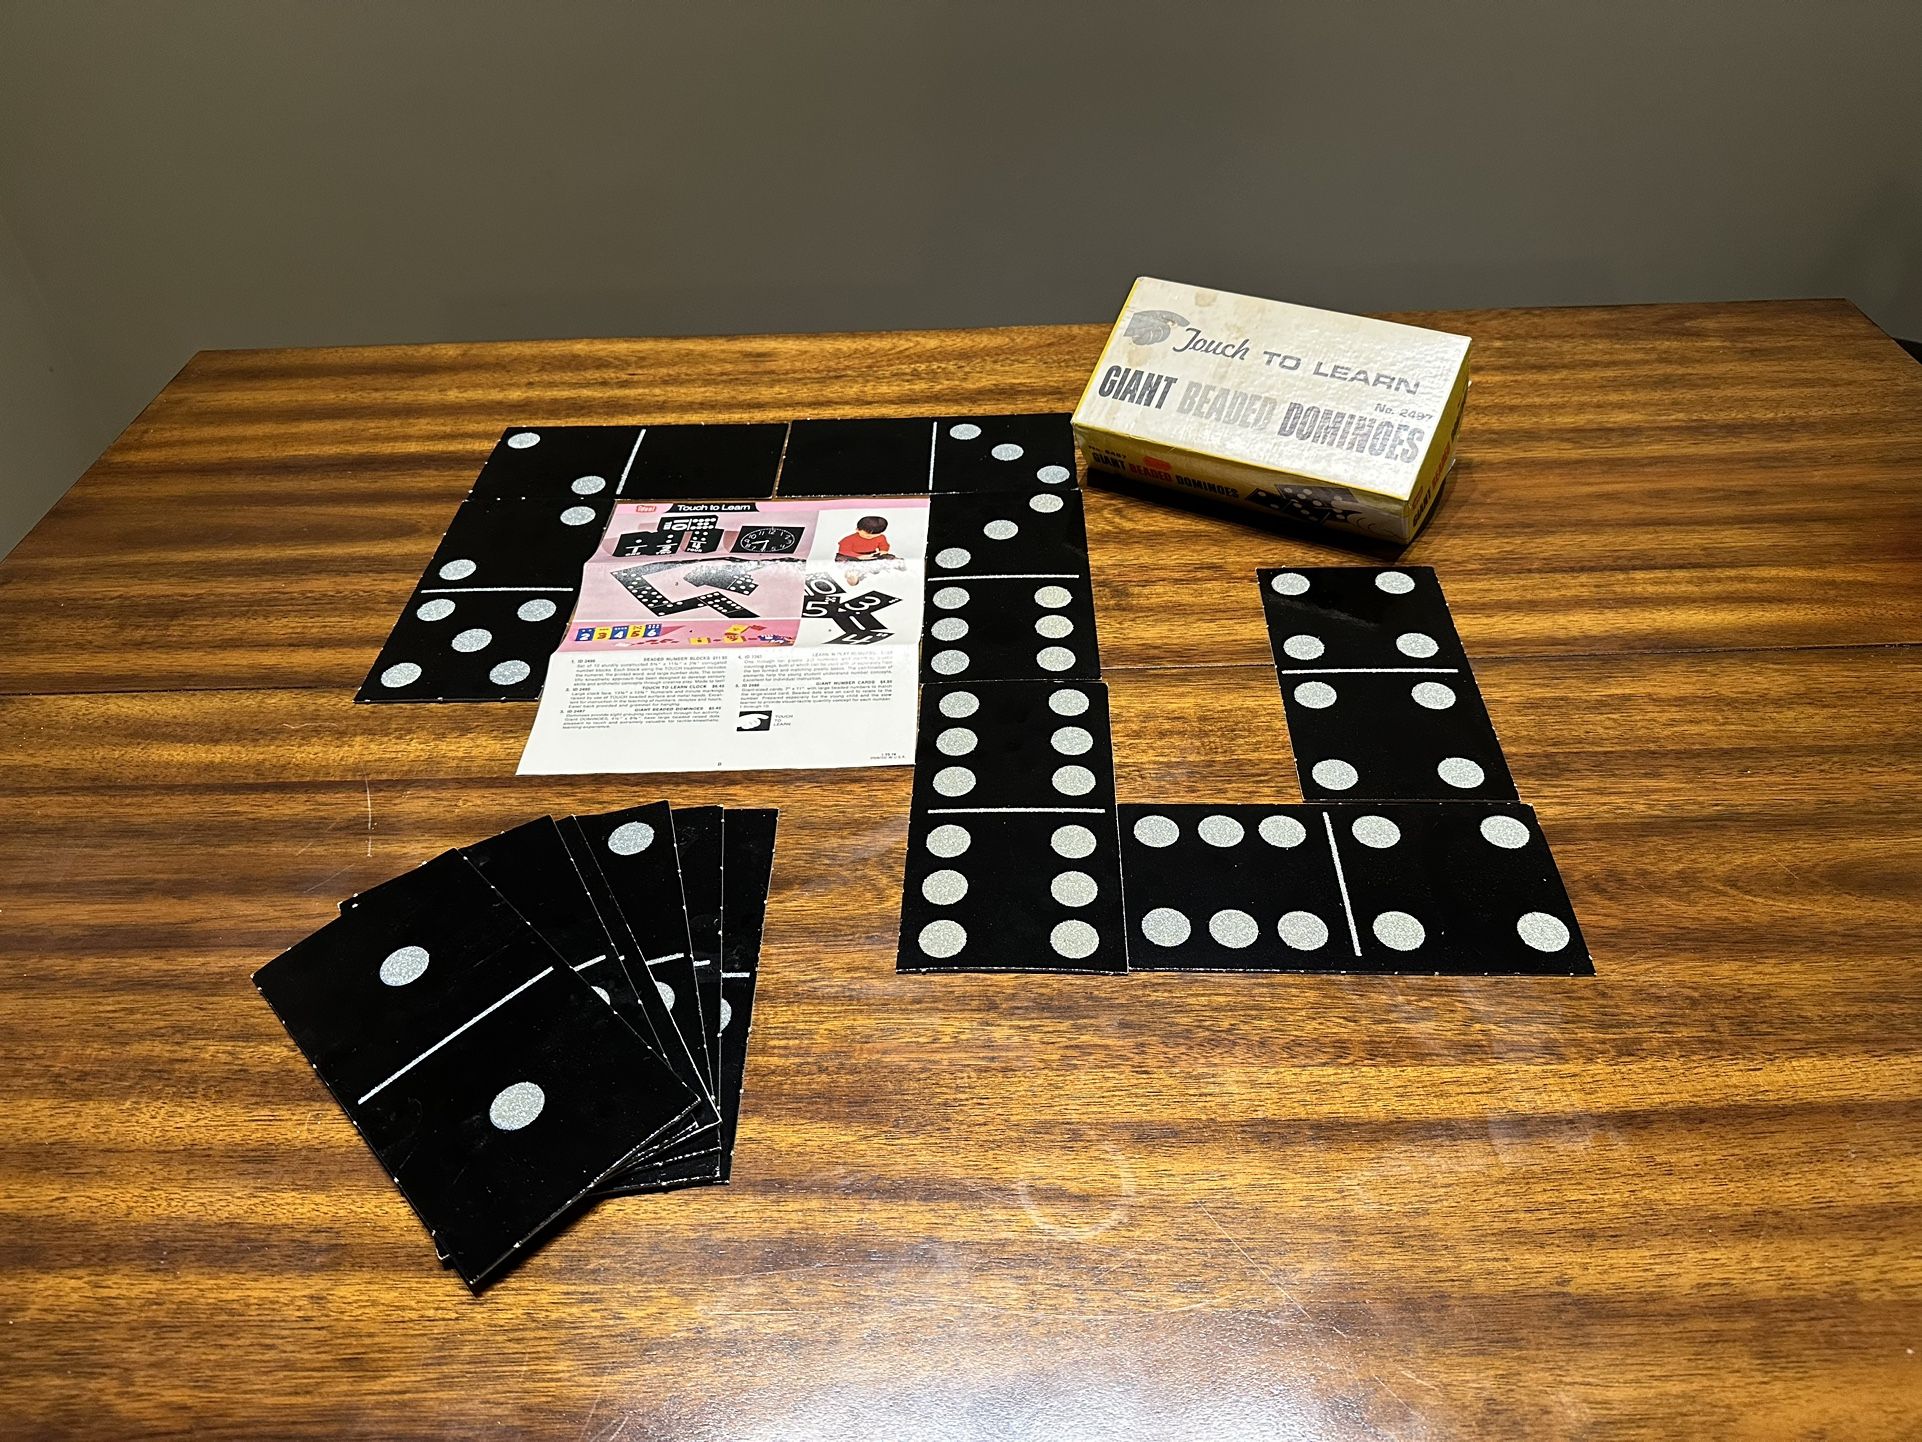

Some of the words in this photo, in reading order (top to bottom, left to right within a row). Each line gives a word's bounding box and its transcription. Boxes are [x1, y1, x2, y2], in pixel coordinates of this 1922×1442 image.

[1172, 326, 1251, 361] Touch
[1263, 350, 1302, 371] TO
[1312, 361, 1420, 395] LEARN
[1098, 364, 1178, 410] GIANT
[1177, 382, 1278, 431] BEADED
[1277, 401, 1425, 464] DOMINOES
[1374, 402, 1396, 416] No.
[1399, 407, 1434, 422] 2497
[1091, 452, 1126, 471] GIANT
[1128, 463, 1173, 483] BEADED
[1175, 474, 1240, 499] DOMINOES
[803, 578, 836, 597] 10
[802, 601, 828, 617] 5
[843, 595, 881, 611] 3
[579, 632, 591, 640] 2
[613, 630, 624, 638] 4
[841, 633, 873, 645] 4
